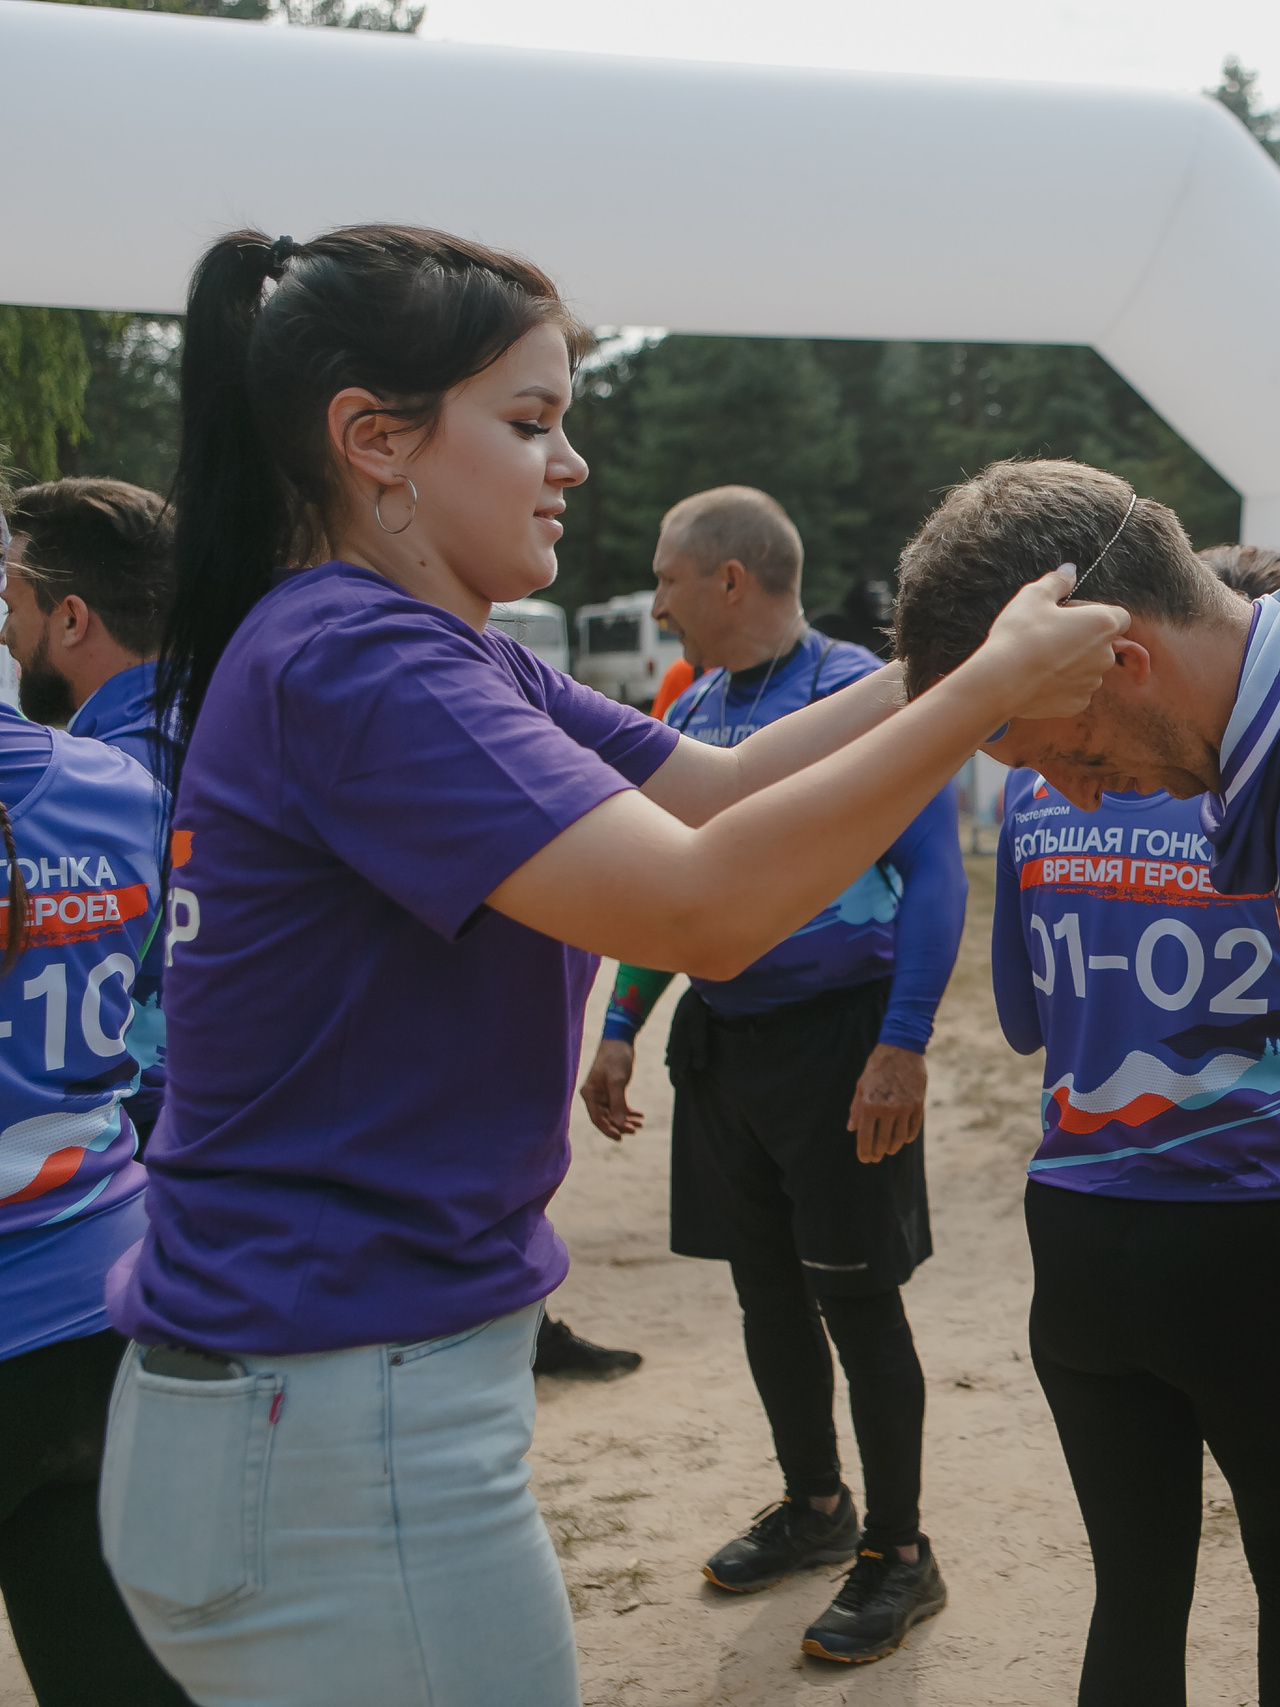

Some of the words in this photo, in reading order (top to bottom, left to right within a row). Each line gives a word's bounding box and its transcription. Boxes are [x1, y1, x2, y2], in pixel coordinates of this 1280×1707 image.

[1015, 806, 1070, 824] Ростелеком
[1014, 827, 1124, 863] БОЛЬШАЯ
[1130, 828, 1212, 862] ГОНК
[1043, 859, 1123, 884] ВРЕМЯ
[1129, 860, 1220, 894] ГЕРОЕ
[0, 894, 121, 927] РОЕВ
[1031, 912, 1274, 1019] 01-02
